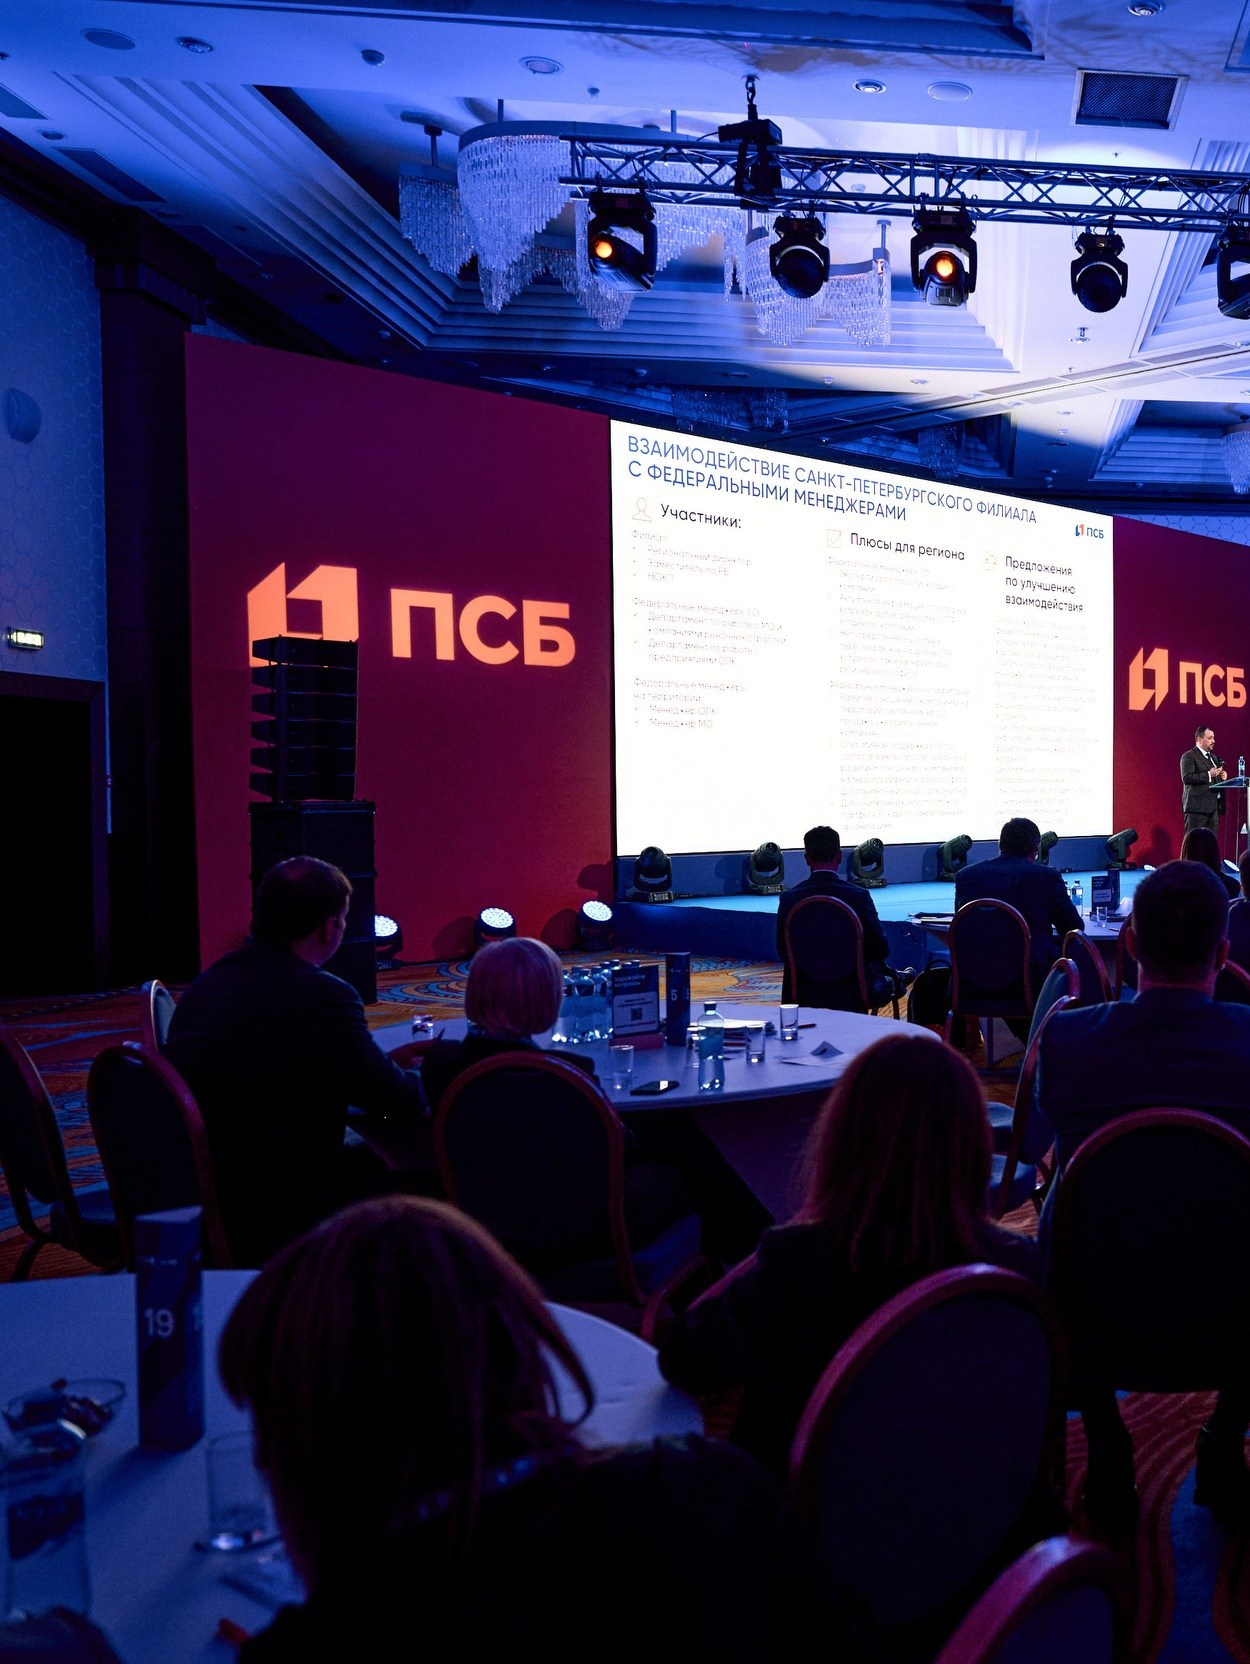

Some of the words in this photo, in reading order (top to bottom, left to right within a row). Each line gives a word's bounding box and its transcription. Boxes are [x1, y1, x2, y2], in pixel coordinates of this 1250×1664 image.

[627, 435, 790, 481] ВЗАИМОДЕЙСТВИЕ
[794, 467, 973, 513] САНКТ-ПЕТЕРБУРГСКОГО
[976, 499, 1037, 524] ФИЛИАЛА
[628, 460, 643, 479] С
[647, 463, 790, 503] ФЕДЕРАЛЬНЫМИ
[794, 489, 907, 522] МЕНЕДЖЕРАМИ
[661, 503, 742, 530] Участники:
[850, 532, 893, 554] Плюсы
[895, 540, 915, 556] для
[917, 545, 965, 562] региона
[1086, 527, 1105, 540] ПСБ
[1005, 555, 1073, 577] Предложения
[1005, 577, 1019, 588] по
[1021, 579, 1076, 597] улучшению
[1005, 595, 1084, 614] взаимодействия
[390, 588, 576, 667] ПСБ
[1179, 661, 1247, 708] ПСБ
[144, 1307, 175, 1338] 19
